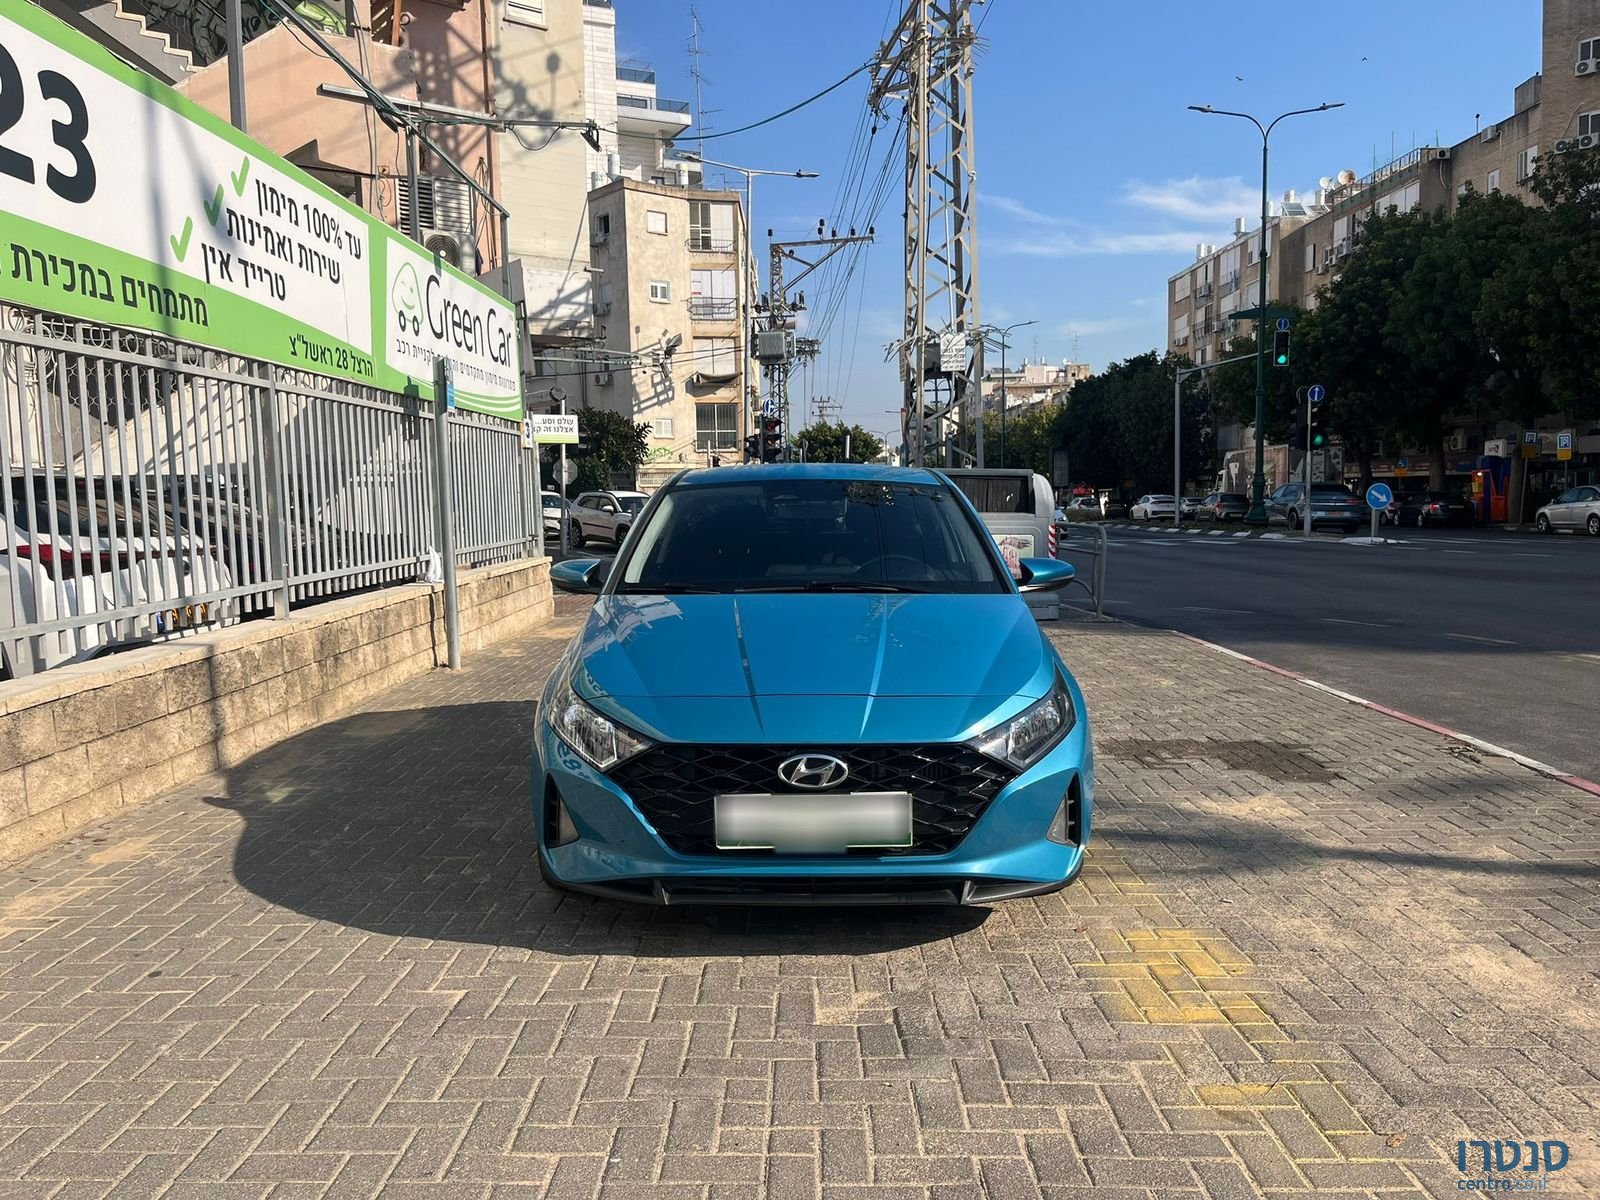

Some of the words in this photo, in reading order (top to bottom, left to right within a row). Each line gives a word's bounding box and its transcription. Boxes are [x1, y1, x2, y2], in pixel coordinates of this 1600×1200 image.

[256, 179, 299, 227] מימון
[226, 207, 293, 264] ואמינות
[304, 204, 342, 250] 100%
[345, 230, 361, 259] עד
[10, 243, 115, 302] במכירת
[201, 243, 233, 284] אין
[238, 257, 286, 301] טרייד
[298, 242, 340, 284] שירות
[121, 274, 208, 327] מתמחים
[426, 274, 484, 357] Green
[487, 308, 512, 368] Car
[335, 347, 349, 370] 28
[350, 351, 374, 377] הרצל
[396, 339, 411, 356] רכב
[557, 417, 574, 425] שלם
